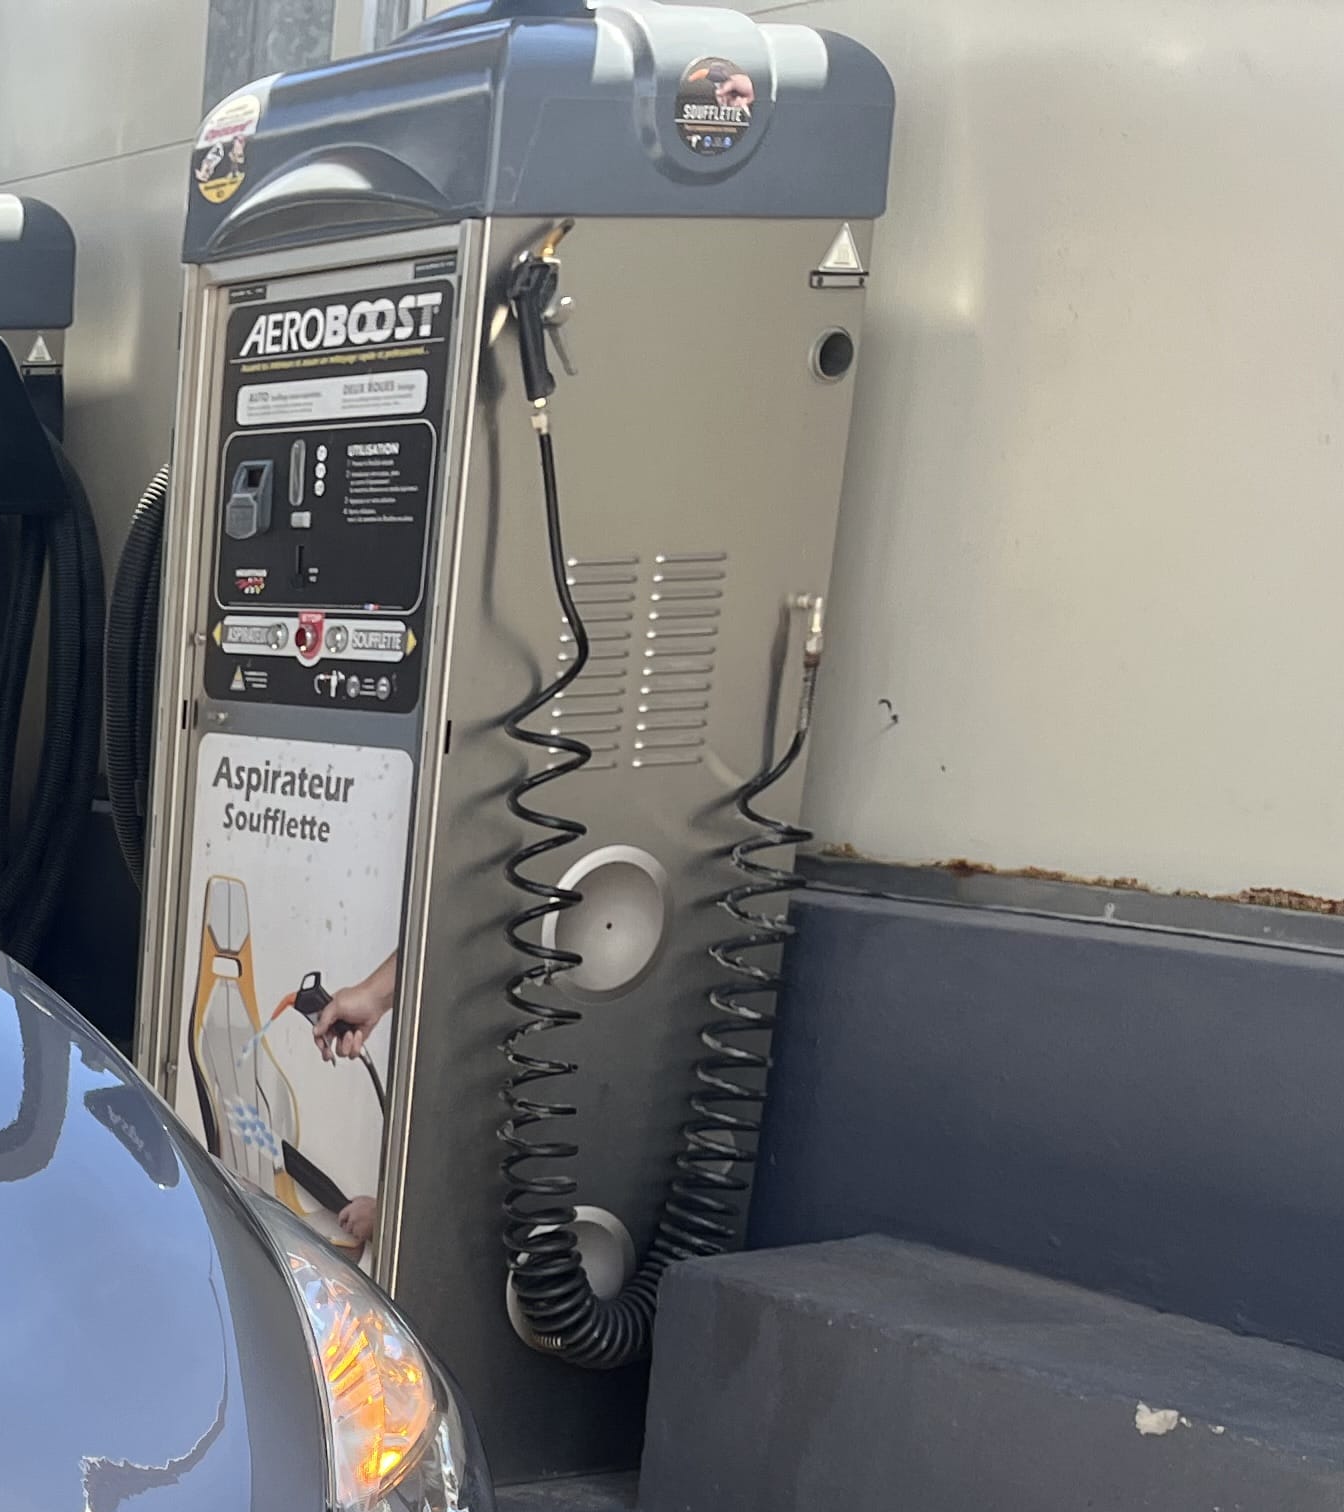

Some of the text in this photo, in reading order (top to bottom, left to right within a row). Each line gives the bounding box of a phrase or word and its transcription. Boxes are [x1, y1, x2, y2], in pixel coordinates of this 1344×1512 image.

[683, 104, 742, 121] SOUFFLETTE
[240, 292, 442, 356] AEROBOOST
[212, 756, 354, 802] Aspirateur
[223, 803, 330, 843] Soufflette
